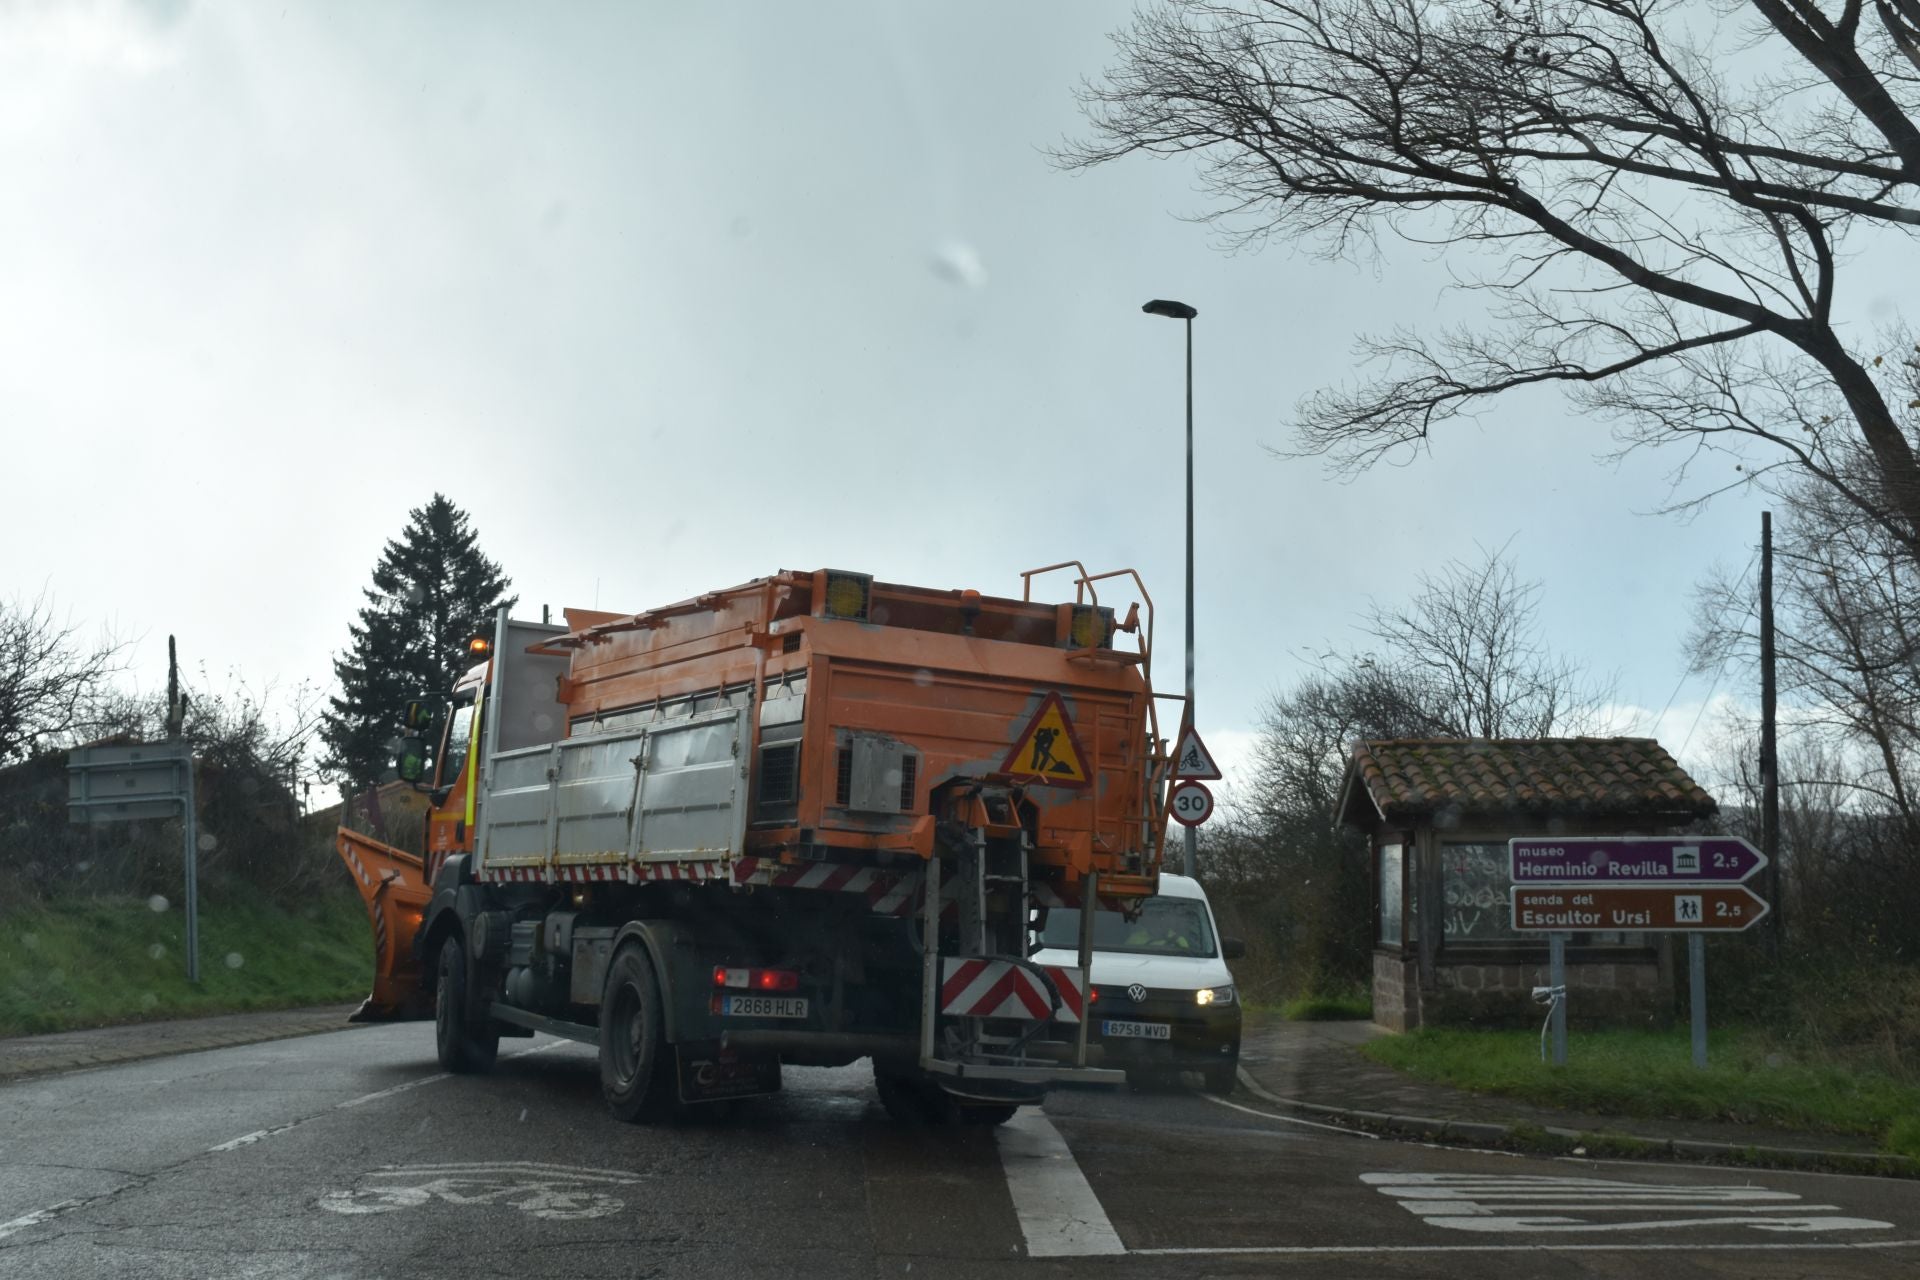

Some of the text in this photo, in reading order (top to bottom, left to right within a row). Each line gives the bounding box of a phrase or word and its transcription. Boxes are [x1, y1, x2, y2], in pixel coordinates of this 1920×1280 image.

[1178, 797, 1204, 811] 30
[1519, 847, 1564, 856] museo
[1712, 852, 1739, 869] 2,5
[1519, 862, 1598, 876] Herminio
[1608, 861, 1668, 876] Revilla
[1522, 894, 1564, 906] senda
[1572, 893, 1594, 906] del
[1522, 909, 1651, 926] Escultor Ursi
[1715, 902, 1742, 918] 2,5
[734, 998, 804, 1016] 2868 HLR
[1110, 1023, 1167, 1037] 6758 MVD
